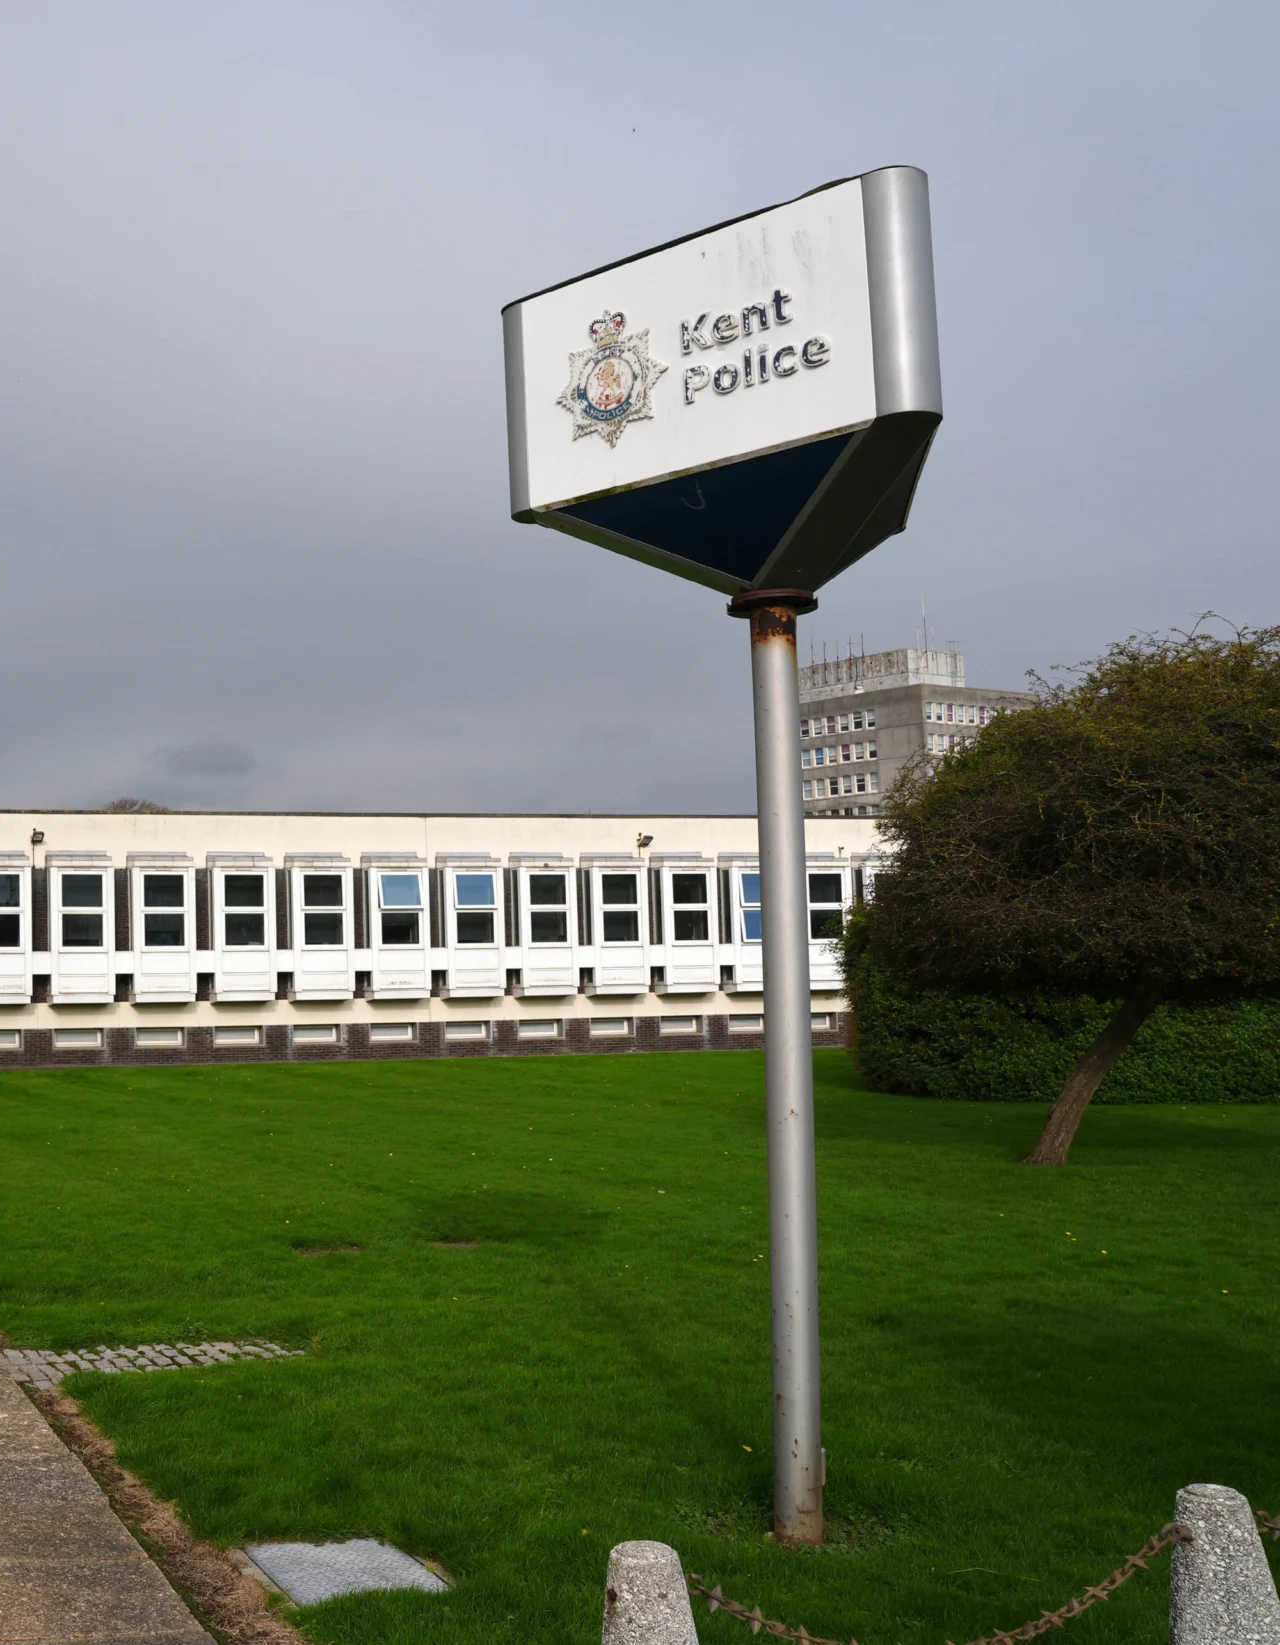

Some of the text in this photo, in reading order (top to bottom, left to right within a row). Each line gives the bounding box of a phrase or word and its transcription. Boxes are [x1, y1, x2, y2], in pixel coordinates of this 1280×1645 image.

[680, 287, 793, 355] Kent
[683, 334, 831, 405] Police
[592, 402, 631, 419] POLICE
